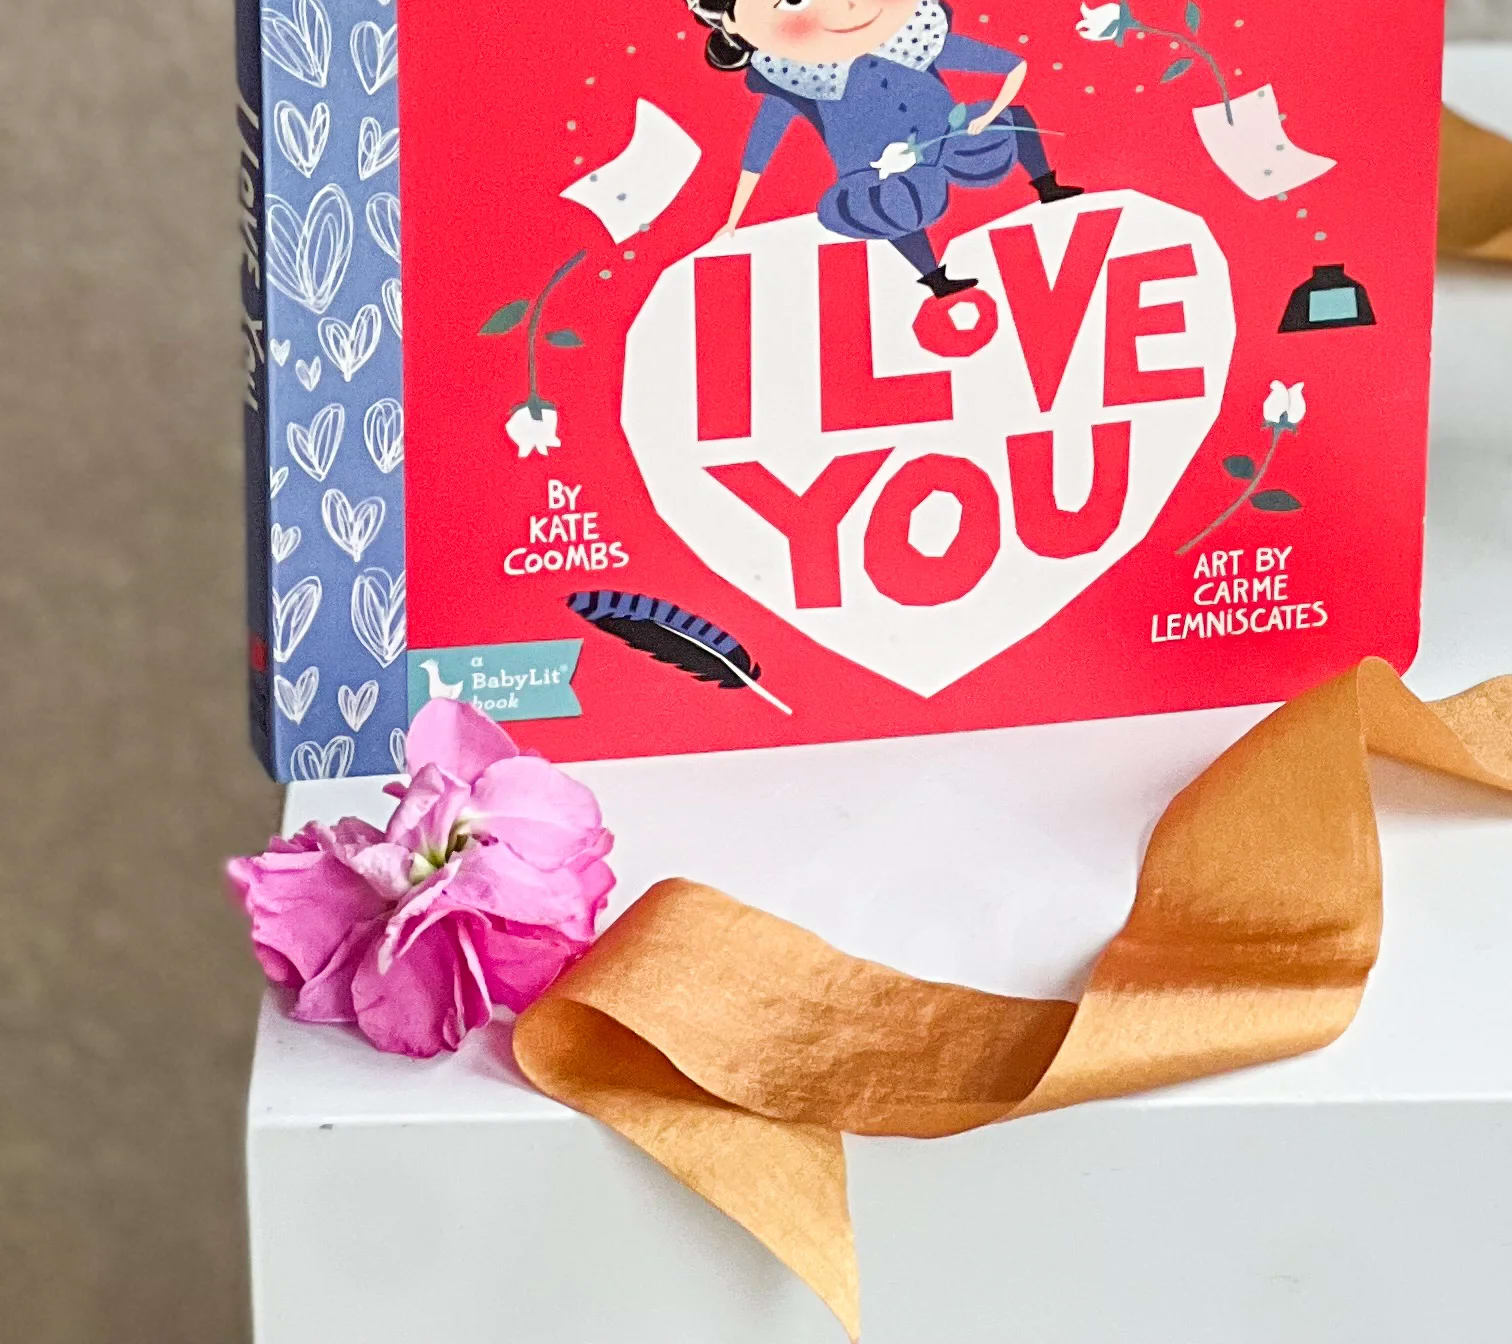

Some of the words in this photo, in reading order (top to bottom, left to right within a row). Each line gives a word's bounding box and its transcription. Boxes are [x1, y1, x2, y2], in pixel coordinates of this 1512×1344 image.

[817, 206, 1206, 433] LOVE
[693, 253, 752, 442] I
[547, 479, 583, 511] BY
[529, 512, 600, 544] KATE
[701, 420, 1132, 610] YOU
[503, 541, 630, 576] COOMBS
[1193, 548, 1245, 579] ART
[1255, 545, 1293, 573] BY
[1193, 574, 1289, 606] CARME
[471, 655, 484, 667] a
[472, 692, 520, 710] book
